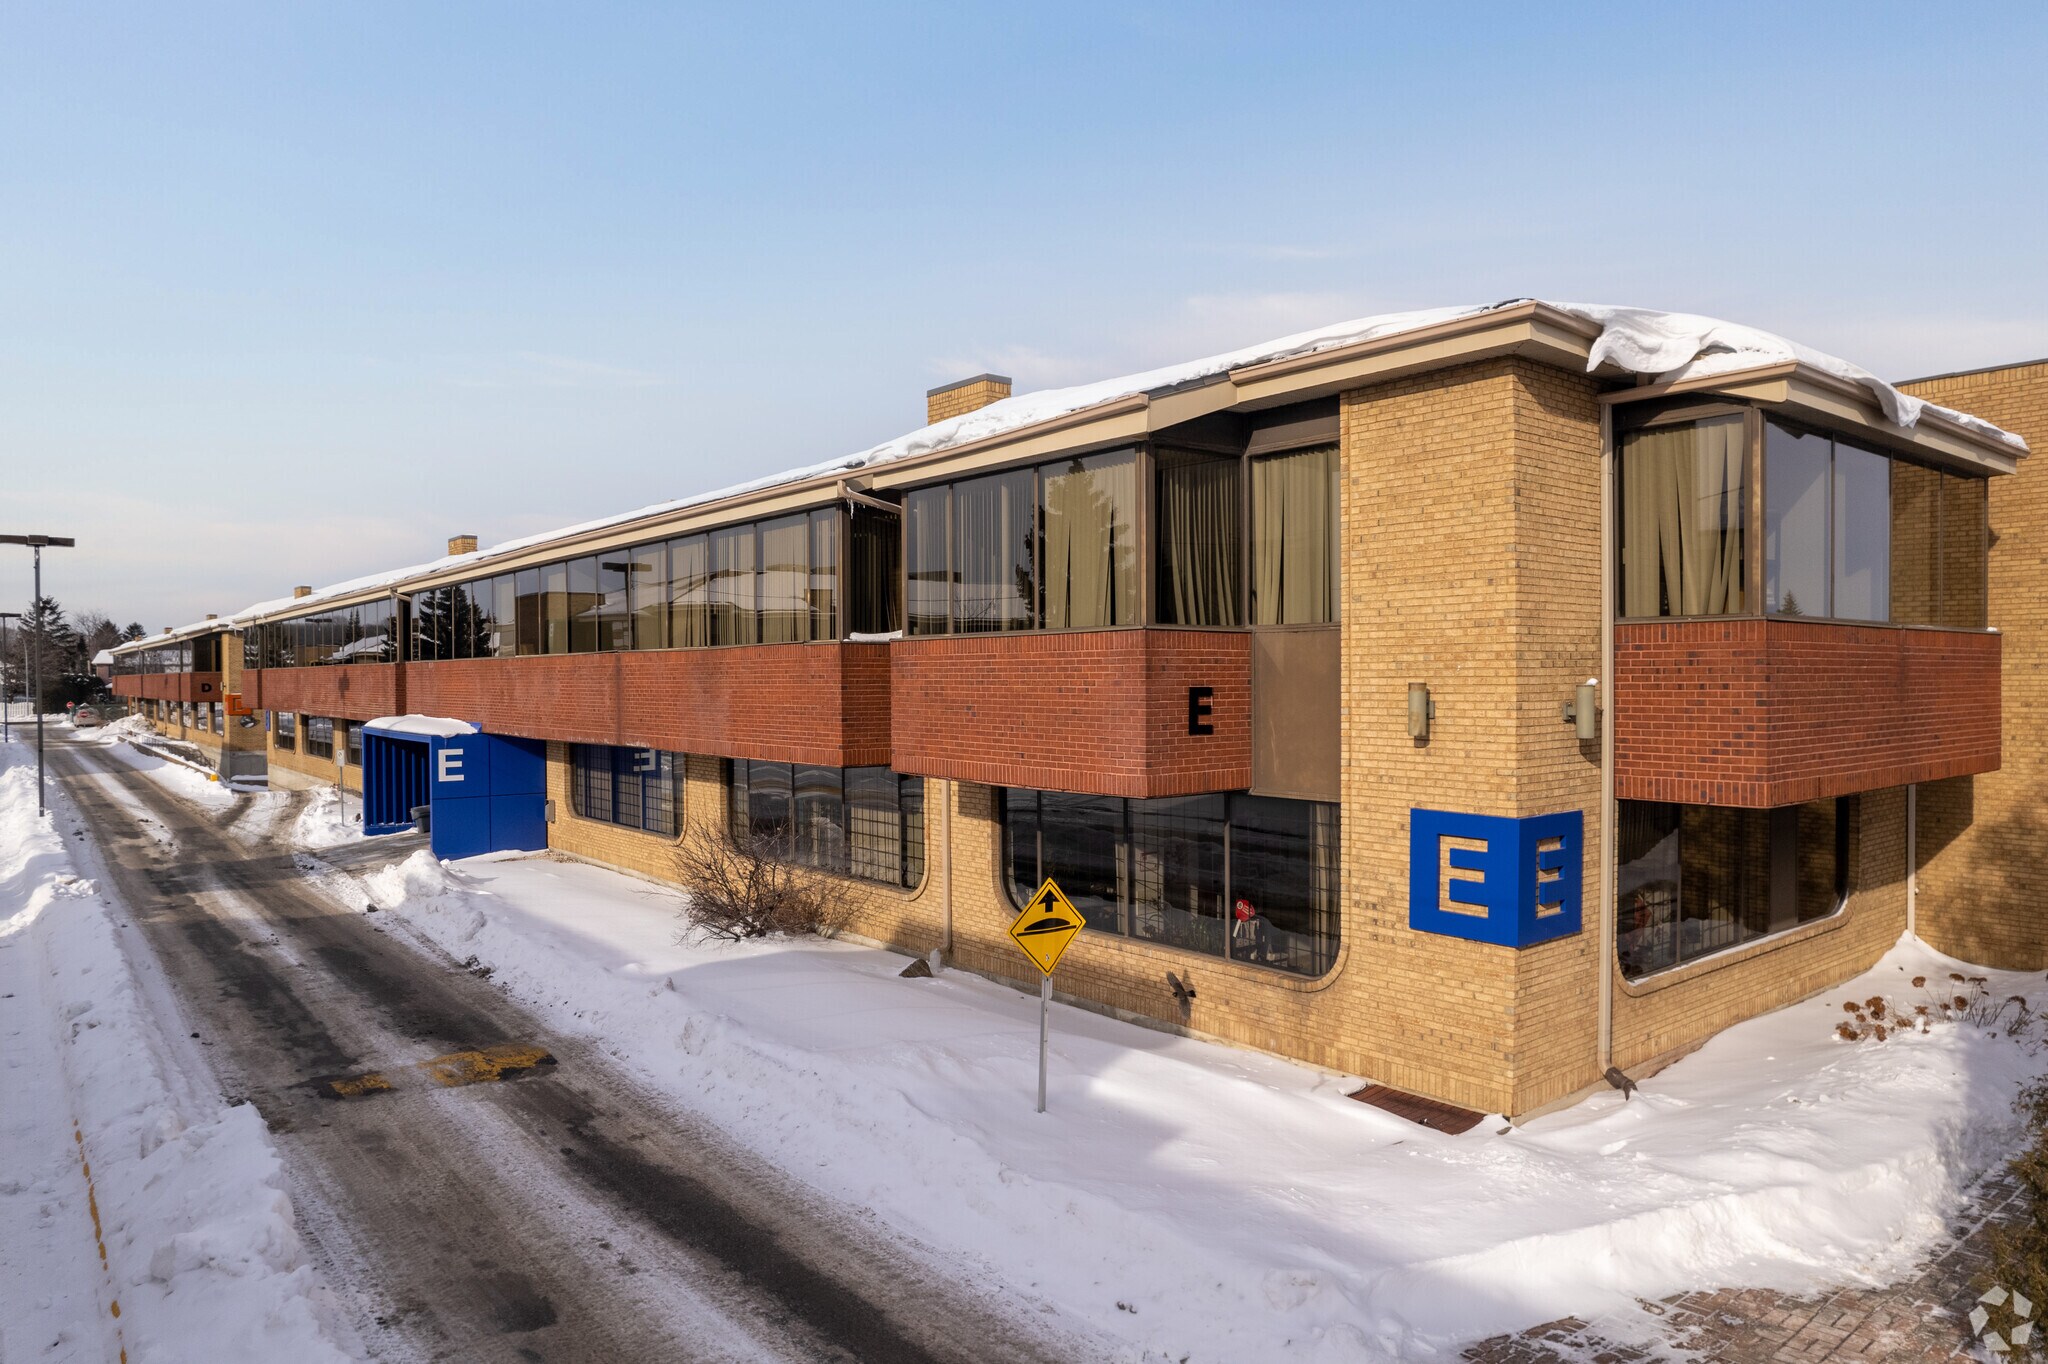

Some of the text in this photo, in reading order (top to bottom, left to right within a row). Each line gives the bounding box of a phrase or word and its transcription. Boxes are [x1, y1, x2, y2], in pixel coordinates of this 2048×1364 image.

[201, 683, 212, 692] D
[1189, 687, 1214, 736] E
[438, 748, 465, 782] E
[1438, 833, 1489, 918] E
[1535, 834, 1566, 920] E
